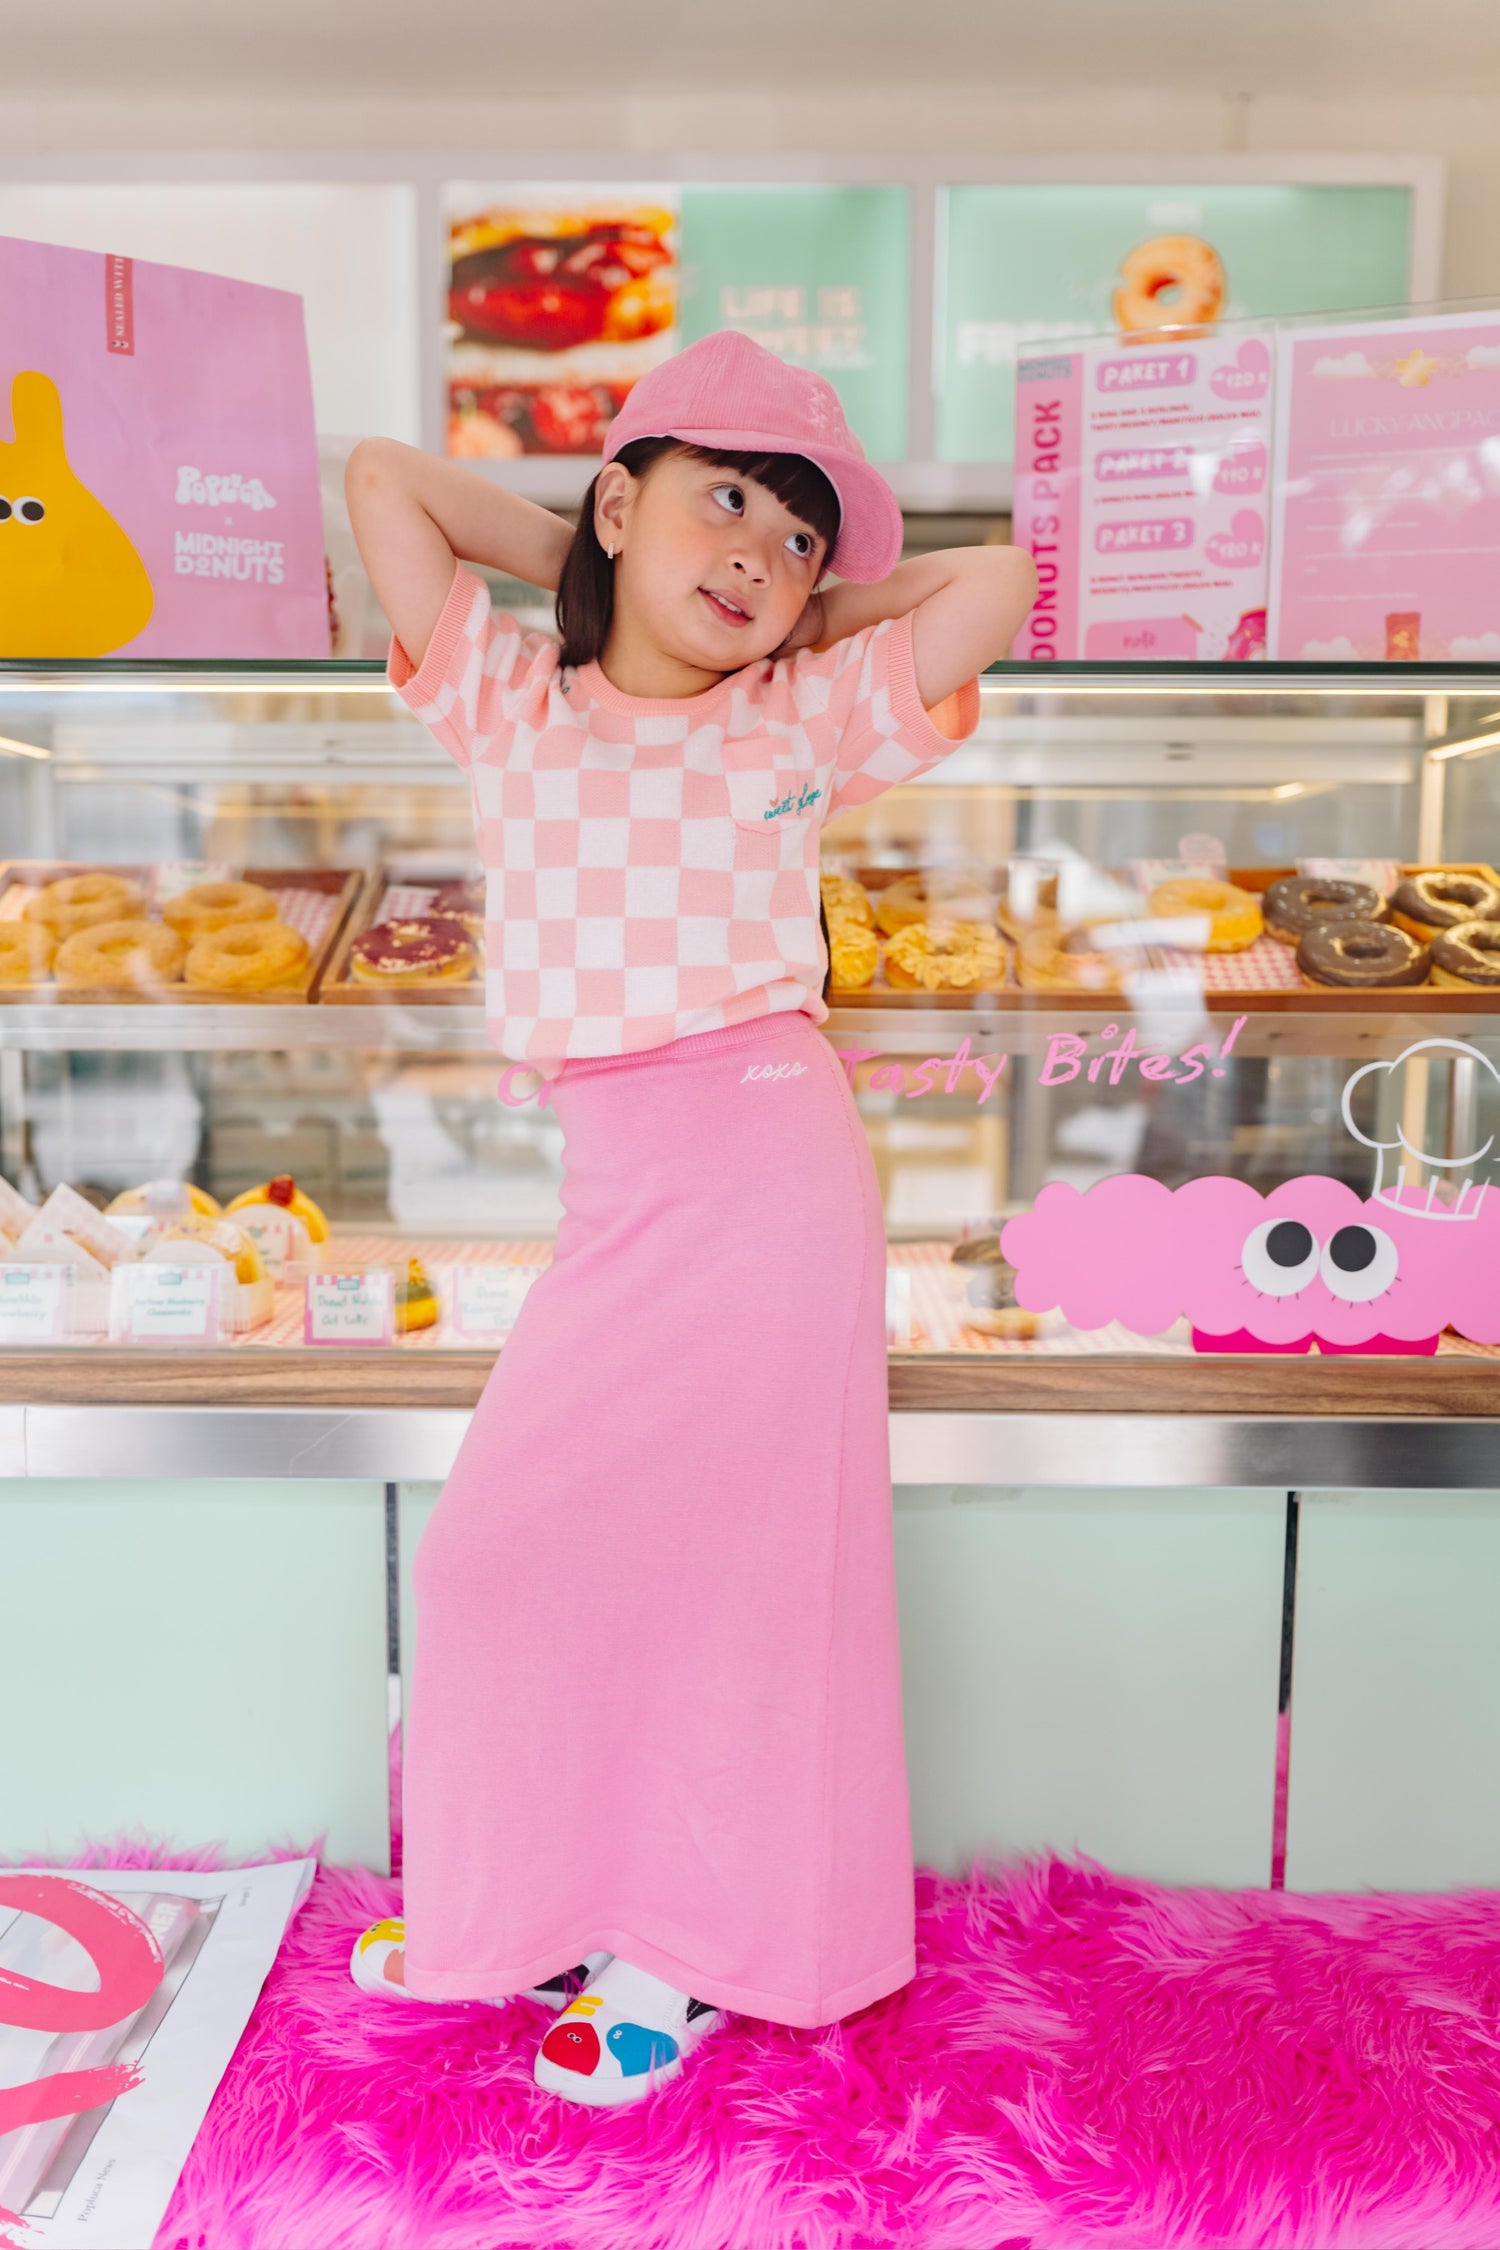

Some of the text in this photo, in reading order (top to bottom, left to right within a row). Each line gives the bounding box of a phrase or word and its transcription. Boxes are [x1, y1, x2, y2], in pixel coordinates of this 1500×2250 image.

[1103, 356, 1190, 388] PAKET 1
[1031, 398, 1063, 500] PACK
[175, 530, 285, 556] MIDNIGHT
[1100, 520, 1187, 548] PAKET 3
[175, 555, 285, 585] DONUTS
[738, 1061, 808, 1085] xoxo
[838, 1015, 1249, 1104] Tasty Bites!
